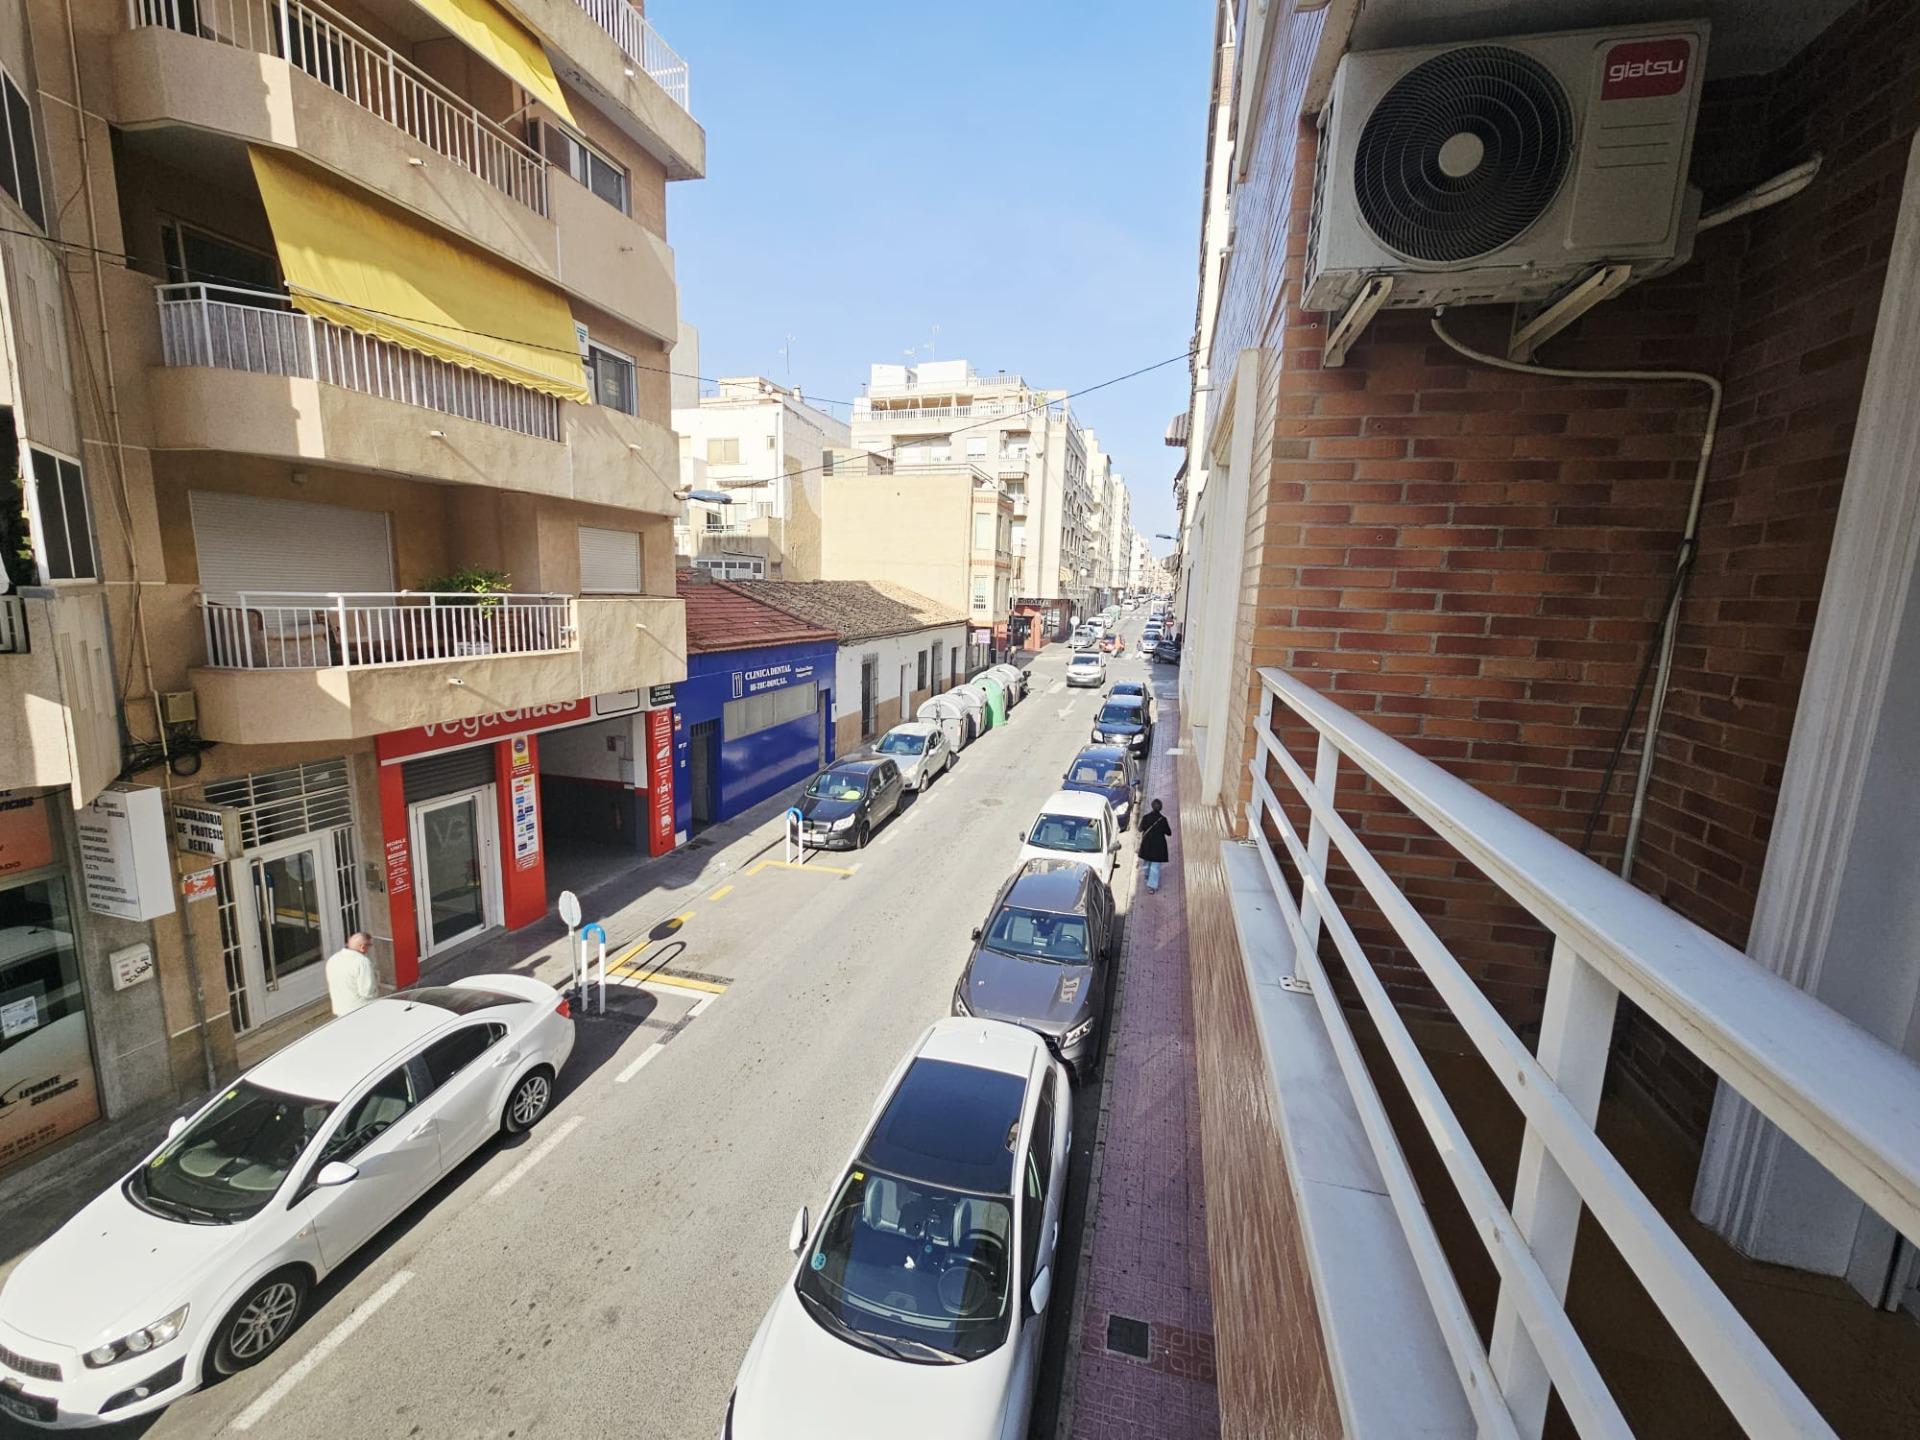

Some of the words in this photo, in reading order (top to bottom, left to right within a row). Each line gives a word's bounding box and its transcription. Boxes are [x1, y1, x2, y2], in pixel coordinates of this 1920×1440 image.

[1608, 59, 1684, 83] giatsu
[745, 668, 769, 681] CLINICA
[770, 664, 791, 677] DENTAL
[174, 806, 222, 826] LABORATORIO
[176, 821, 188, 835] DE
[190, 824, 224, 841] PROTESIS
[188, 838, 216, 855] DENTAL
[19, 1074, 62, 1100] LEVANTE
